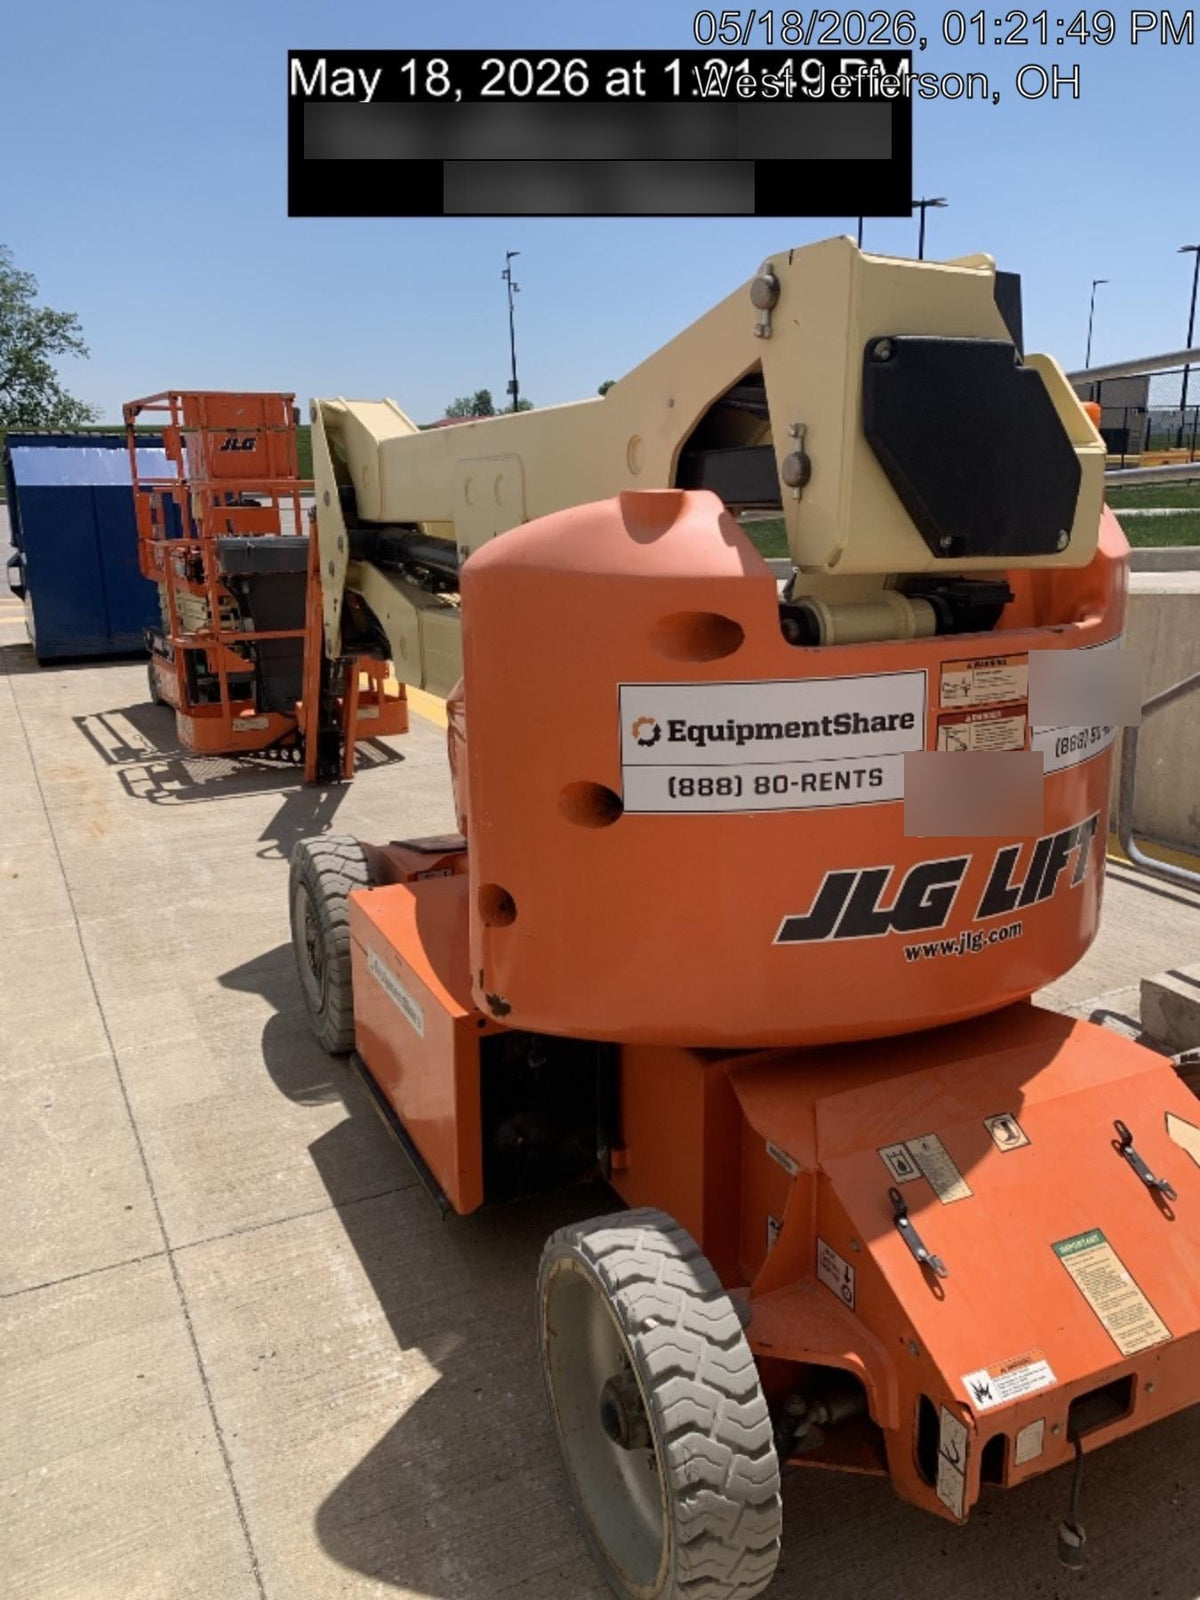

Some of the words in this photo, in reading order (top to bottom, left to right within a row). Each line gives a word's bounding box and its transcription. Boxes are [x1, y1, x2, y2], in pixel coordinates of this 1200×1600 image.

[220, 437, 257, 451] JLG
[667, 712, 915, 747] EquipmentShare
[668, 775, 743, 799] (888)
[754, 768, 884, 795] 80-RENTS
[772, 854, 973, 944] JLG
[973, 809, 1101, 921] LIFT
[903, 921, 1023, 962] www.jlg.com
